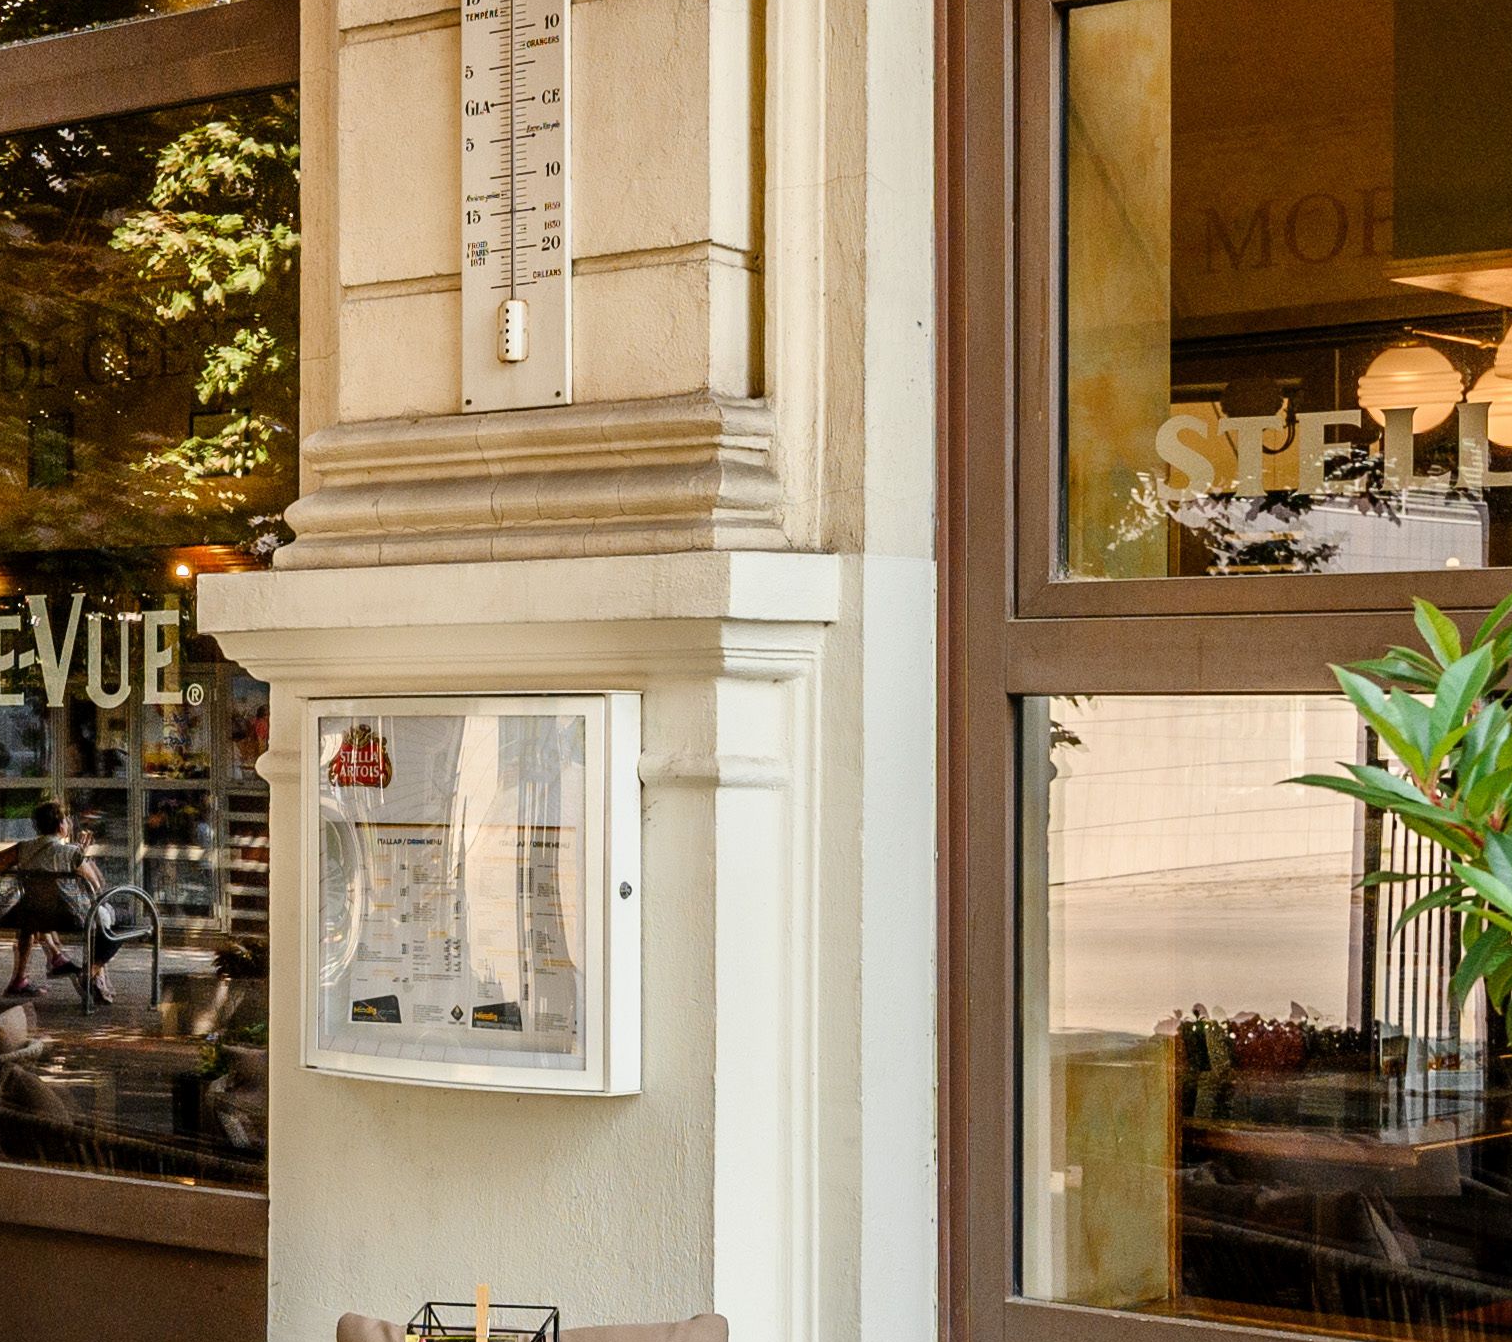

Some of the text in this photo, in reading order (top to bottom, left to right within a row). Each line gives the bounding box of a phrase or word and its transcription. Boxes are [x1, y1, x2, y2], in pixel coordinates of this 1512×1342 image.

[544, 13, 560, 30] 10
[526, 34, 560, 49] ORANGERS
[465, 65, 474, 79] 5
[465, 88, 560, 117] GLA CE
[465, 139, 474, 152] 5
[545, 161, 560, 177] 10
[466, 211, 481, 226] 15
[541, 235, 560, 251] 20
[340, 765, 379, 777] ARTOIS
